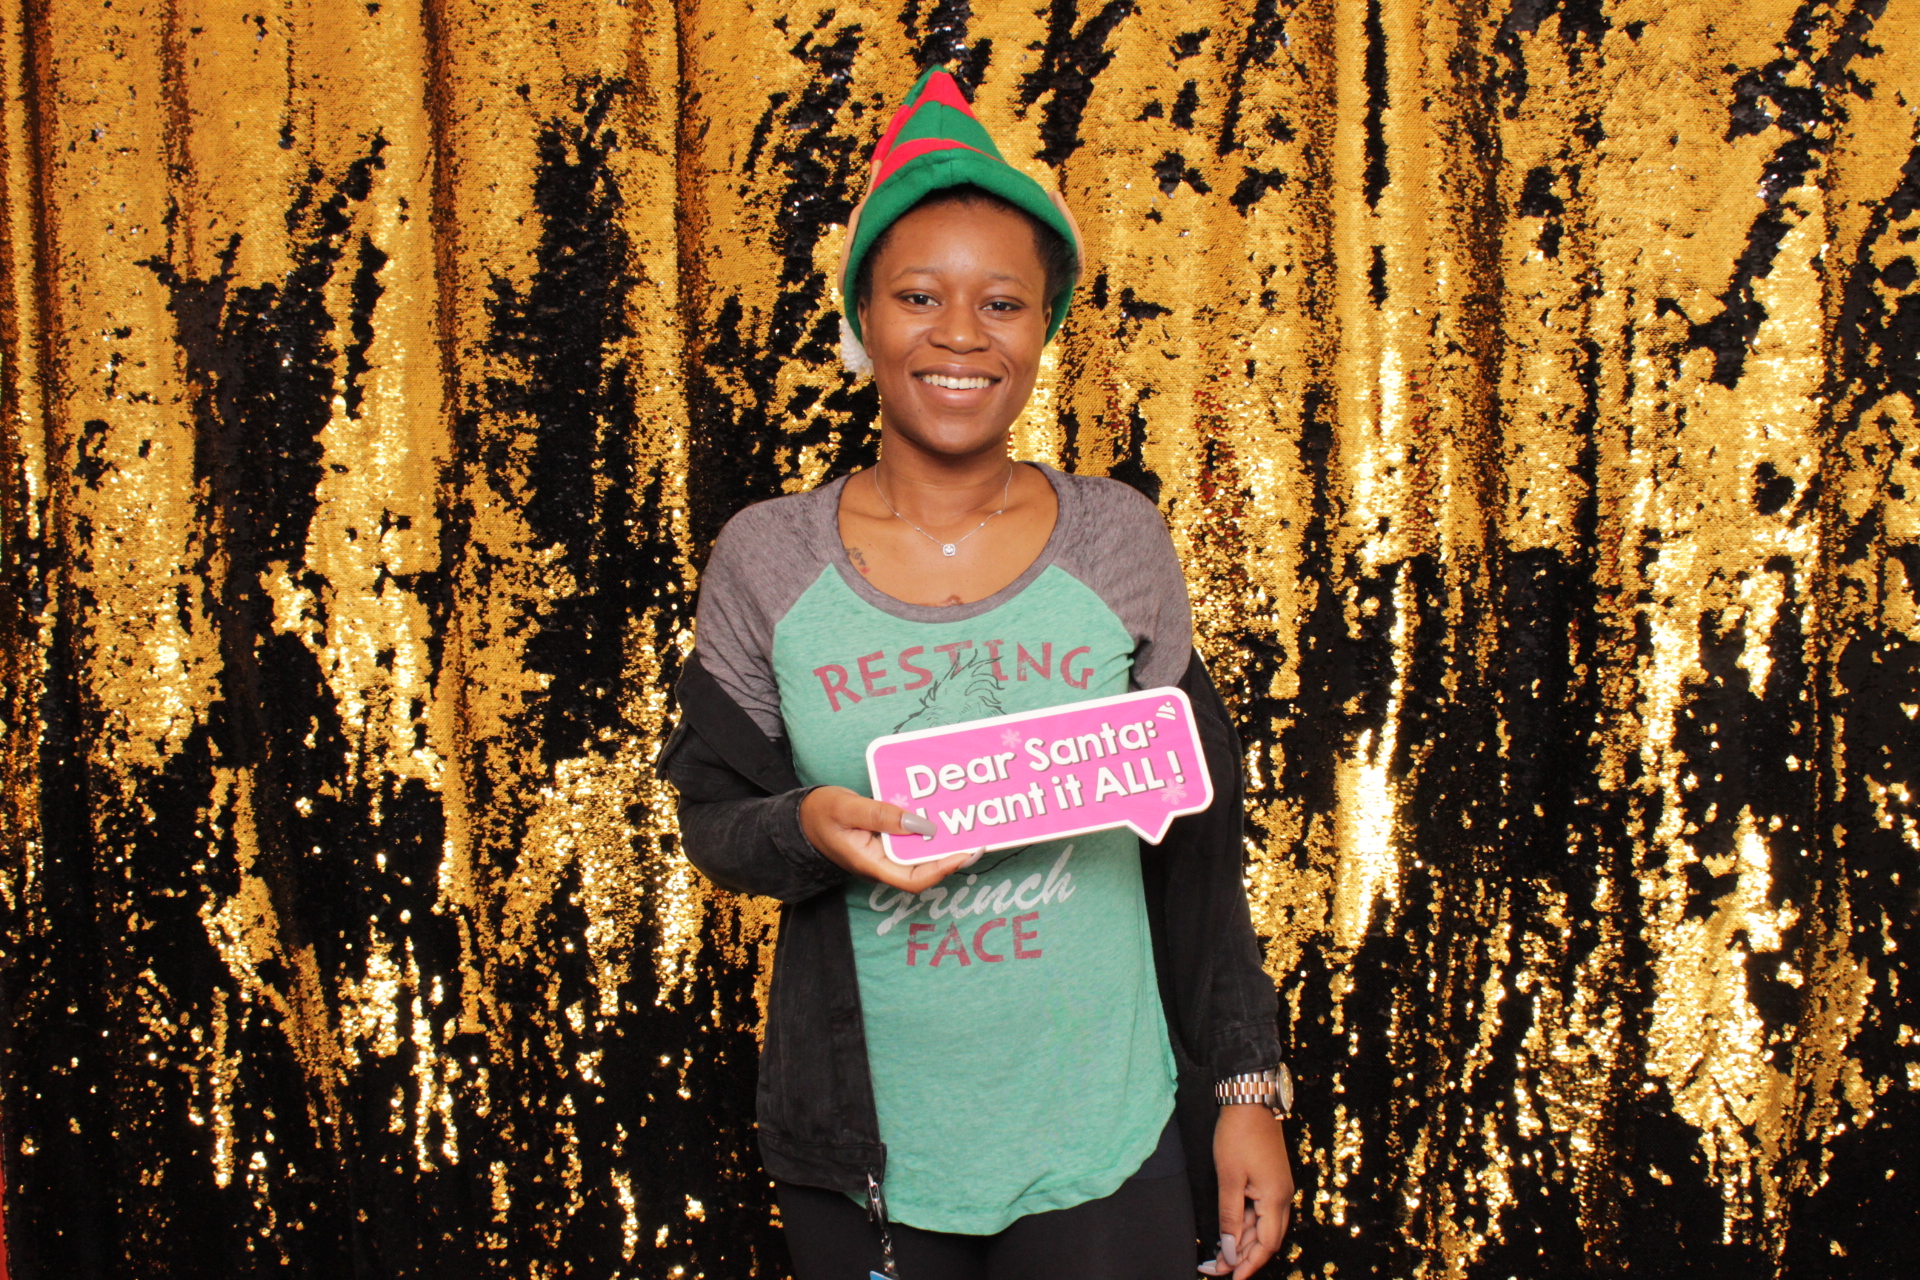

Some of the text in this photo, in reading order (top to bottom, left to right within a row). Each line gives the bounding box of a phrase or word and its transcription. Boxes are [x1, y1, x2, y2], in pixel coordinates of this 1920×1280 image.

[812, 639, 1095, 712] RESTING
[905, 719, 1158, 801] Dear Santa:
[938, 781, 1047, 836] want
[1053, 774, 1083, 811] it
[906, 911, 1043, 968] FACE
